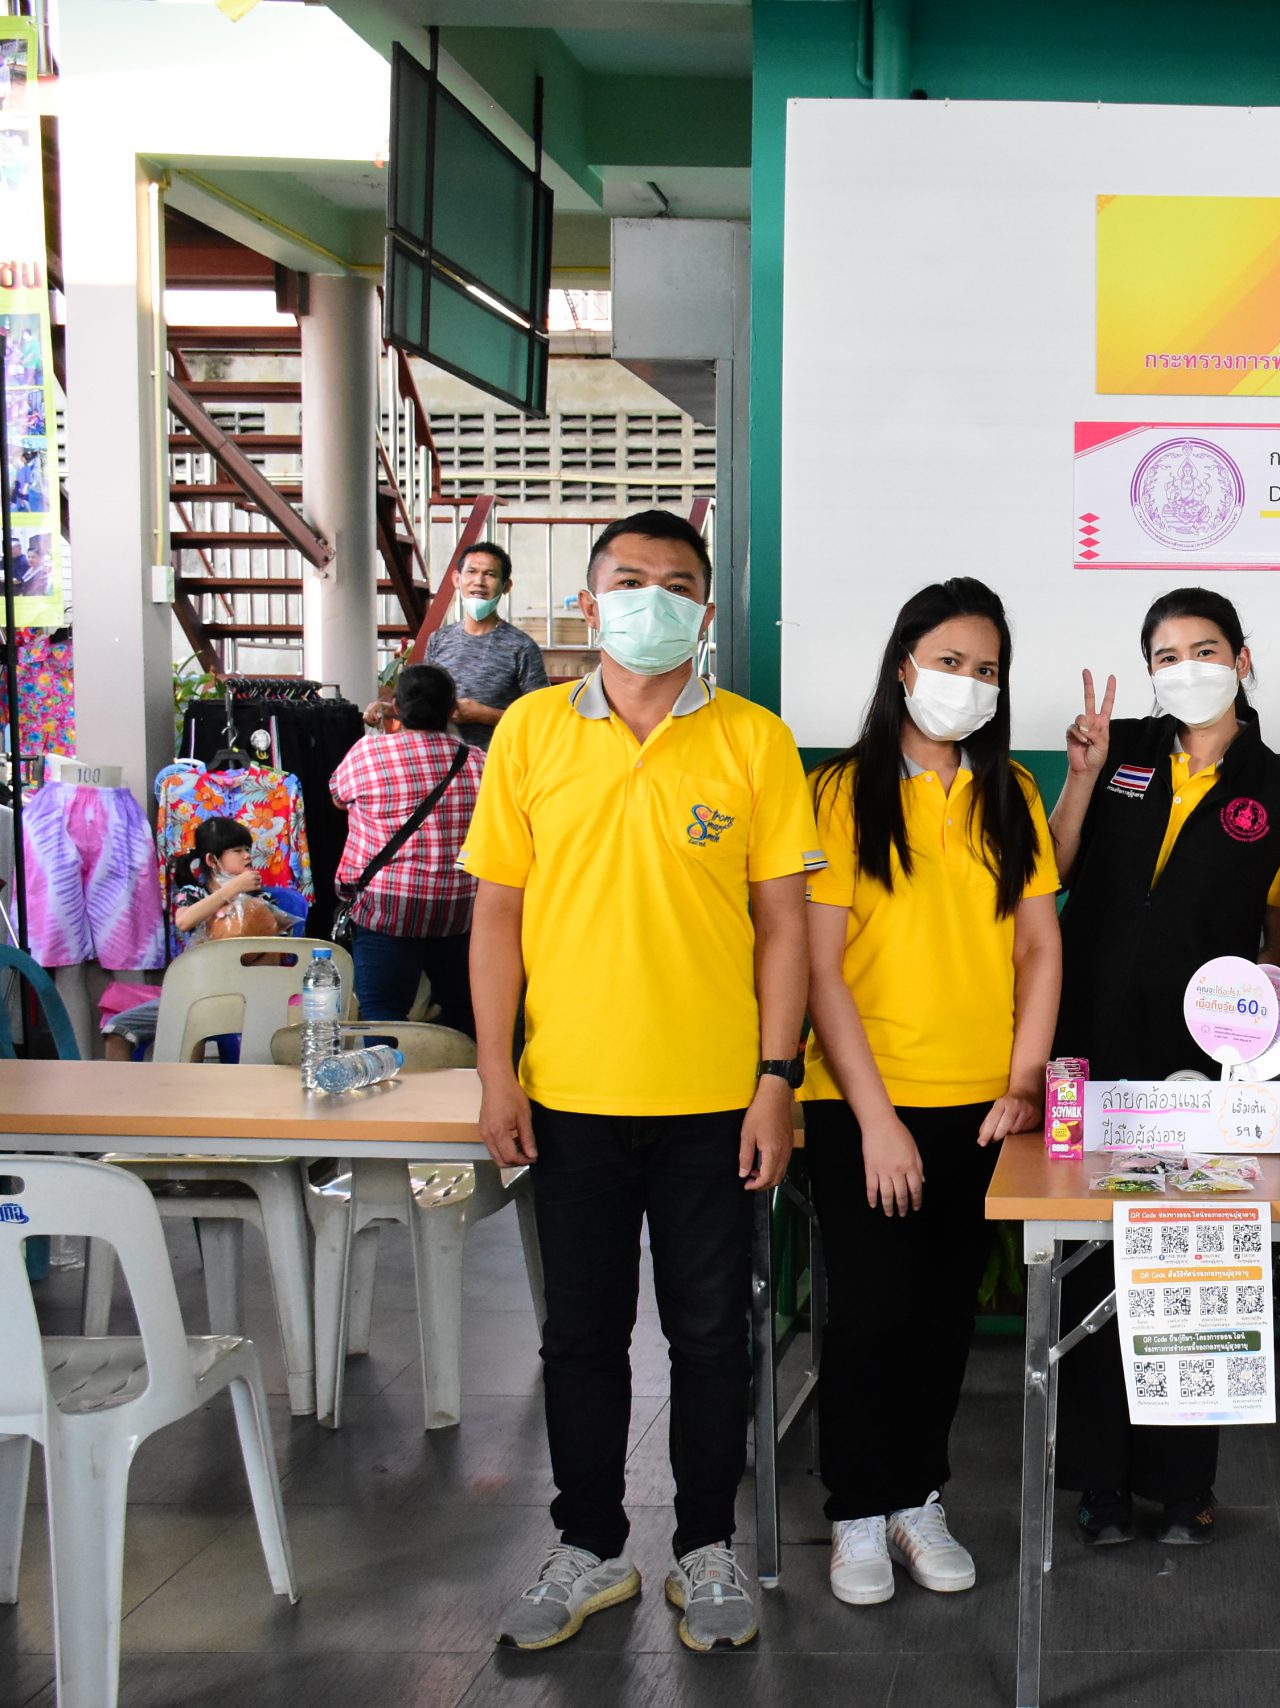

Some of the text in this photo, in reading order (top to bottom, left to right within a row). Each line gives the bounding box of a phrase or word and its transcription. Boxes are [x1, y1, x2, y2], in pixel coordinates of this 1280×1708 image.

[78, 767, 101, 784] 100
[1236, 998, 1259, 1015] 60
[1101, 1086, 1213, 1110] สายคล้องแมส
[1231, 1091, 1267, 1115] เริ่มต้น
[1051, 1105, 1083, 1119] SOYMILK
[1102, 1119, 1186, 1151] ฝีมือผู้สูงอายุ
[1130, 1211, 1140, 1219] QR
[1141, 1211, 1157, 1219] Code
